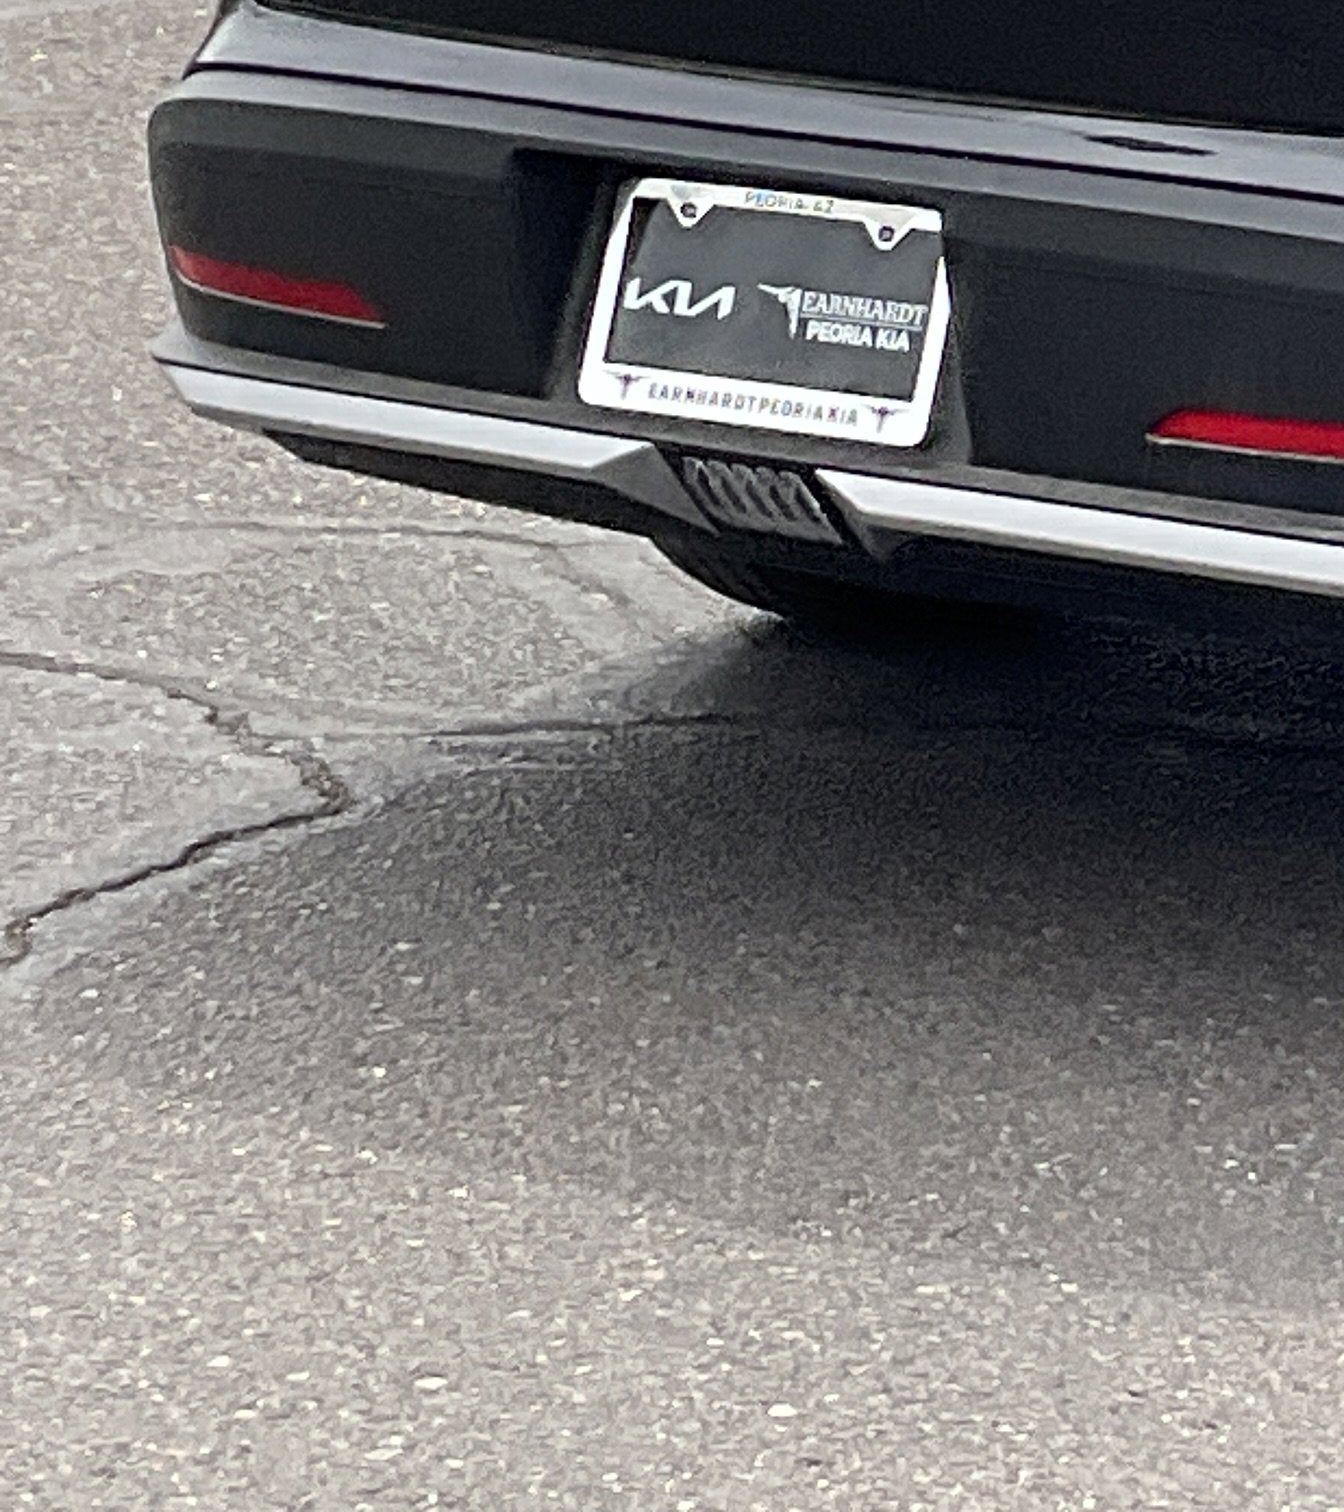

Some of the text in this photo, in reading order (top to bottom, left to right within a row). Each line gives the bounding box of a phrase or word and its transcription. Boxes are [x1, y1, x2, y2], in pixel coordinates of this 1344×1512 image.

[624, 278, 736, 320] KIA
[802, 291, 929, 326] EARNHARDT
[805, 320, 910, 353] PEORIA KIA
